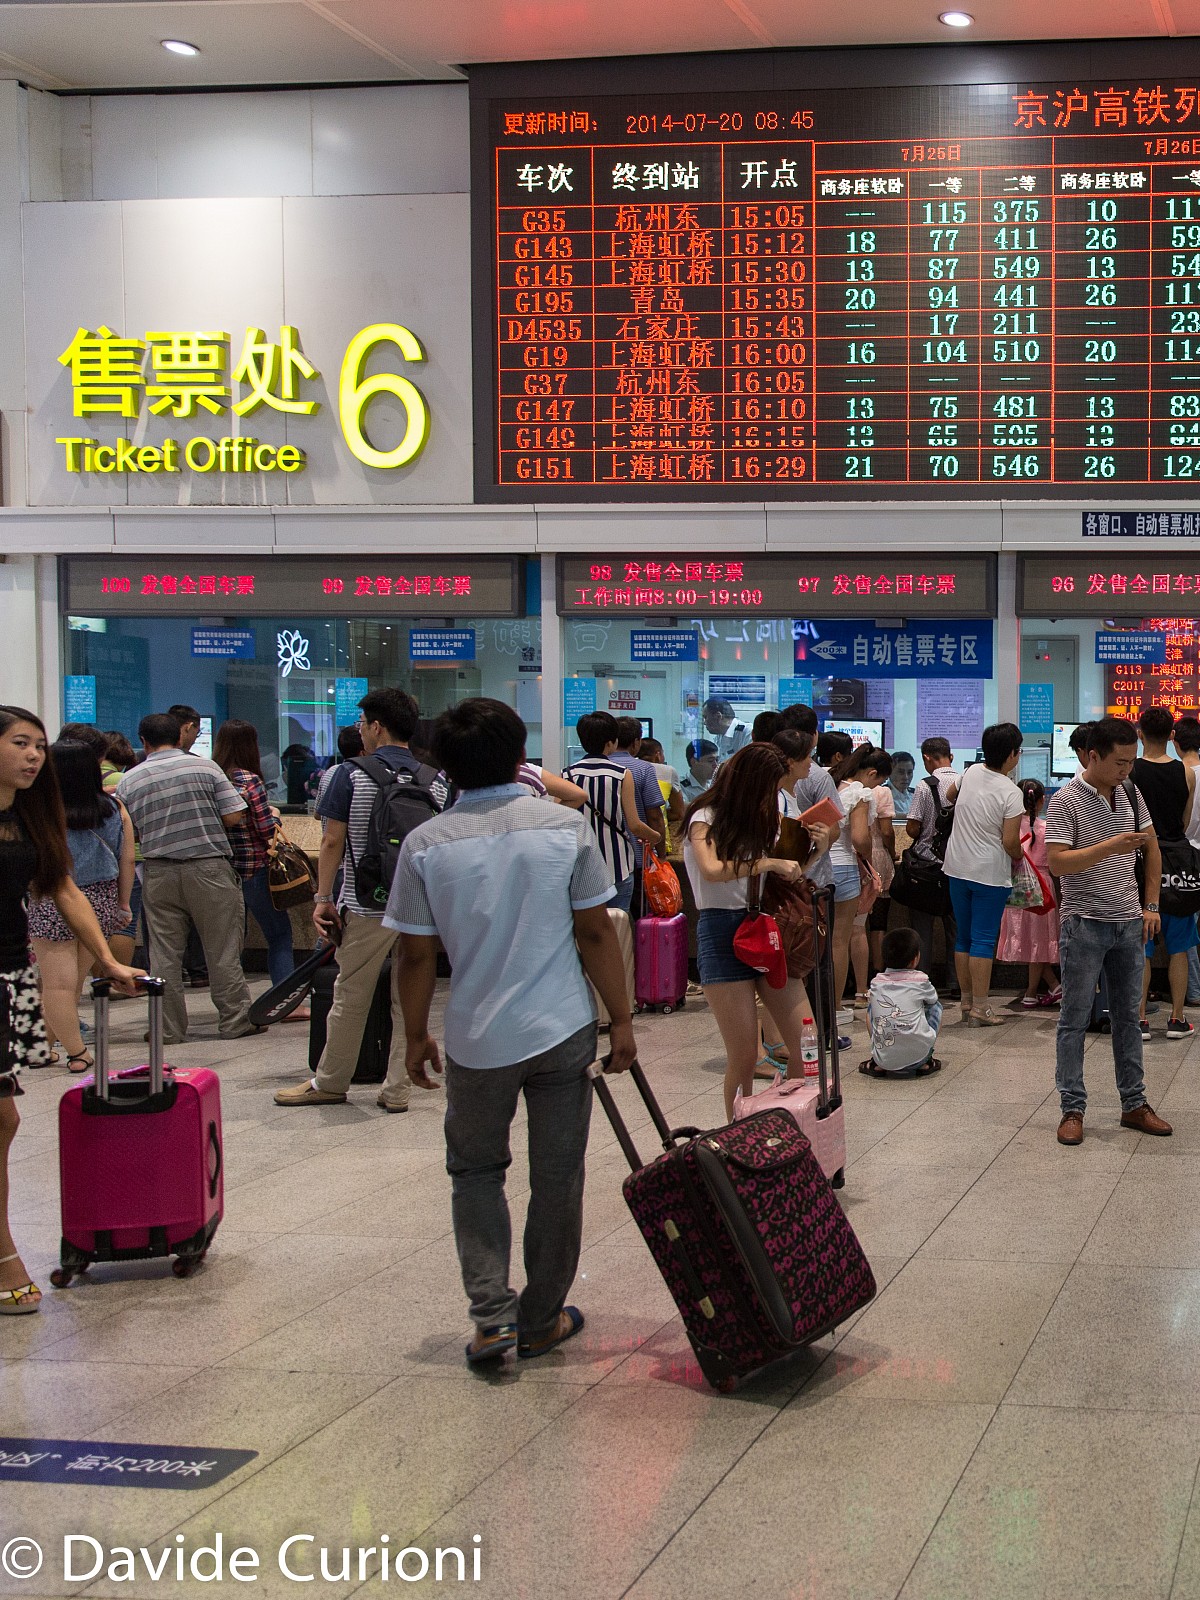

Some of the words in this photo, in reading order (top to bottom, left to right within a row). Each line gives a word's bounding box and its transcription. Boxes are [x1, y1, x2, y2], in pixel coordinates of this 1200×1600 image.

[504, 111, 600, 135] 更新时间:
[627, 113, 742, 133] 2014-07-20
[756, 111, 813, 129] 08:45
[902, 145, 960, 161] 7月25日
[517, 163, 573, 192] 车次
[612, 161, 698, 191] 终到站
[742, 159, 797, 188] 开点
[821, 178, 904, 195] 商务座软卧
[929, 177, 962, 193] 一等
[1004, 175, 1036, 191] 二等
[1061, 172, 1146, 189] 商务座软卧
[523, 211, 565, 231] G35
[615, 207, 703, 230] 杭州东
[733, 206, 804, 228] 15:05
[923, 201, 971, 224] 115
[992, 200, 1038, 222] 375
[1088, 200, 1116, 221] 10
[515, 237, 572, 260] G143
[602, 232, 713, 258] 上海虹桥
[734, 233, 804, 254] 15:12
[515, 264, 572, 286] G145
[602, 259, 713, 285] 上海虹桥
[731, 261, 805, 284] 15:30
[516, 292, 573, 313] G195
[631, 288, 683, 313] 青岛
[732, 288, 804, 312] 15:35
[508, 319, 581, 342] D4535
[617, 316, 700, 340] 石家庄
[733, 316, 804, 339] 15:43
[524, 347, 567, 367] G19
[602, 342, 715, 368] 上海虹桥
[733, 344, 805, 367] 16:00
[57, 325, 321, 418] 售票处
[524, 374, 567, 396] G37
[616, 370, 700, 395] 杭州东
[734, 372, 804, 394] 16:05
[339, 322, 430, 470] 6
[516, 400, 574, 420] G147
[602, 397, 714, 422] 上海虹桥
[732, 399, 805, 419] 16:10
[56, 437, 179, 474] Ticket
[185, 436, 303, 473] Office
[517, 458, 573, 478] G151
[602, 454, 714, 480] 上海虹桥
[734, 457, 805, 477] 16:29
[846, 457, 873, 477] 21
[930, 456, 958, 476] 70
[993, 455, 1038, 476] 546
[1085, 456, 1115, 477] 26
[102, 578, 130, 593] 100
[140, 575, 254, 595] 发售全国车票
[590, 565, 612, 580] 98
[624, 562, 743, 583] 发售全国车票
[799, 578, 820, 592] 97
[832, 575, 955, 595] 发售全国车票
[1052, 577, 1074, 592] 96
[354, 576, 471, 596] 发售全国车票
[574, 586, 762, 606] 工作时间8:00-19:00
[816, 646, 844, 654] 200米
[853, 633, 979, 666] 自动售票专区
[1116, 666, 1142, 675] G113
[1151, 663, 1193, 676] 上海虹桥
[1113, 681, 1145, 691] C2017
[1159, 680, 1183, 691] 天津
[1116, 696, 1142, 705] G115
[1151, 695, 1193, 706] 上海虹桥
